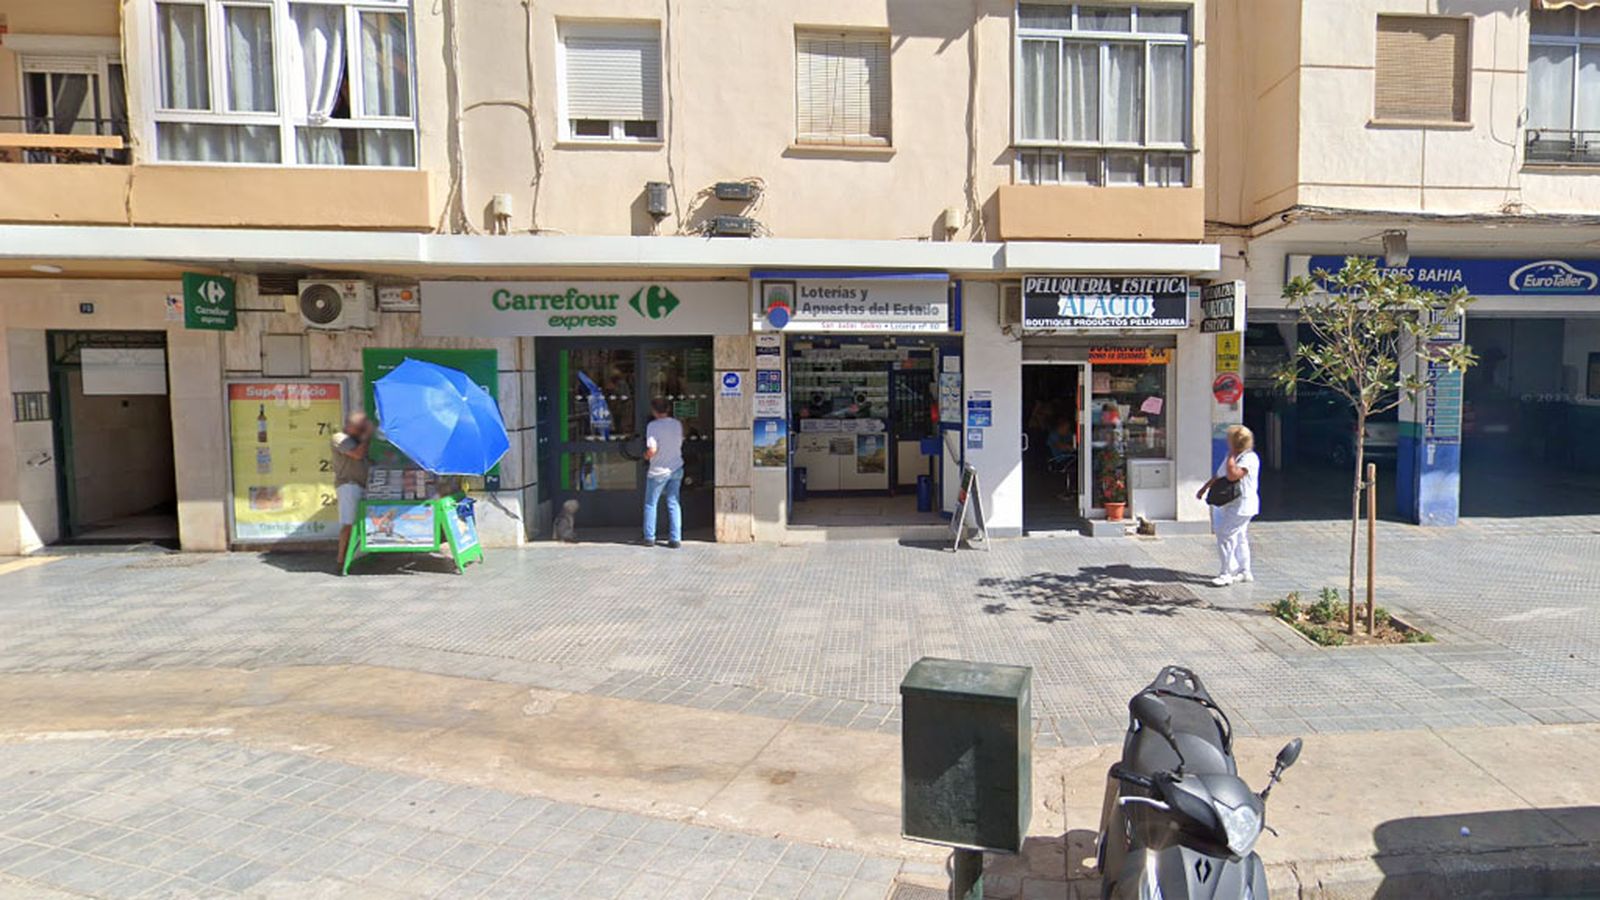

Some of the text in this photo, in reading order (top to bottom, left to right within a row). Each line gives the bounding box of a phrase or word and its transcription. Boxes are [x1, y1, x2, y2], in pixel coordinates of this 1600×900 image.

[1418, 269, 1463, 282] BAHIA
[1522, 273, 1586, 287] EuroTaller
[801, 285, 869, 301] Loterías y
[1025, 278, 1112, 294] PELUQUERIA
[1121, 277, 1186, 294] ESTETICA
[492, 288, 620, 311] Carrefour
[1060, 294, 1150, 317] ALACIO
[194, 305, 230, 317] Carrefour
[802, 302, 941, 317] Apuestas del Estado
[548, 315, 618, 330] express
[1025, 318, 1186, 327] BOUTIQUE PRODUCTOS PELUQUERIA
